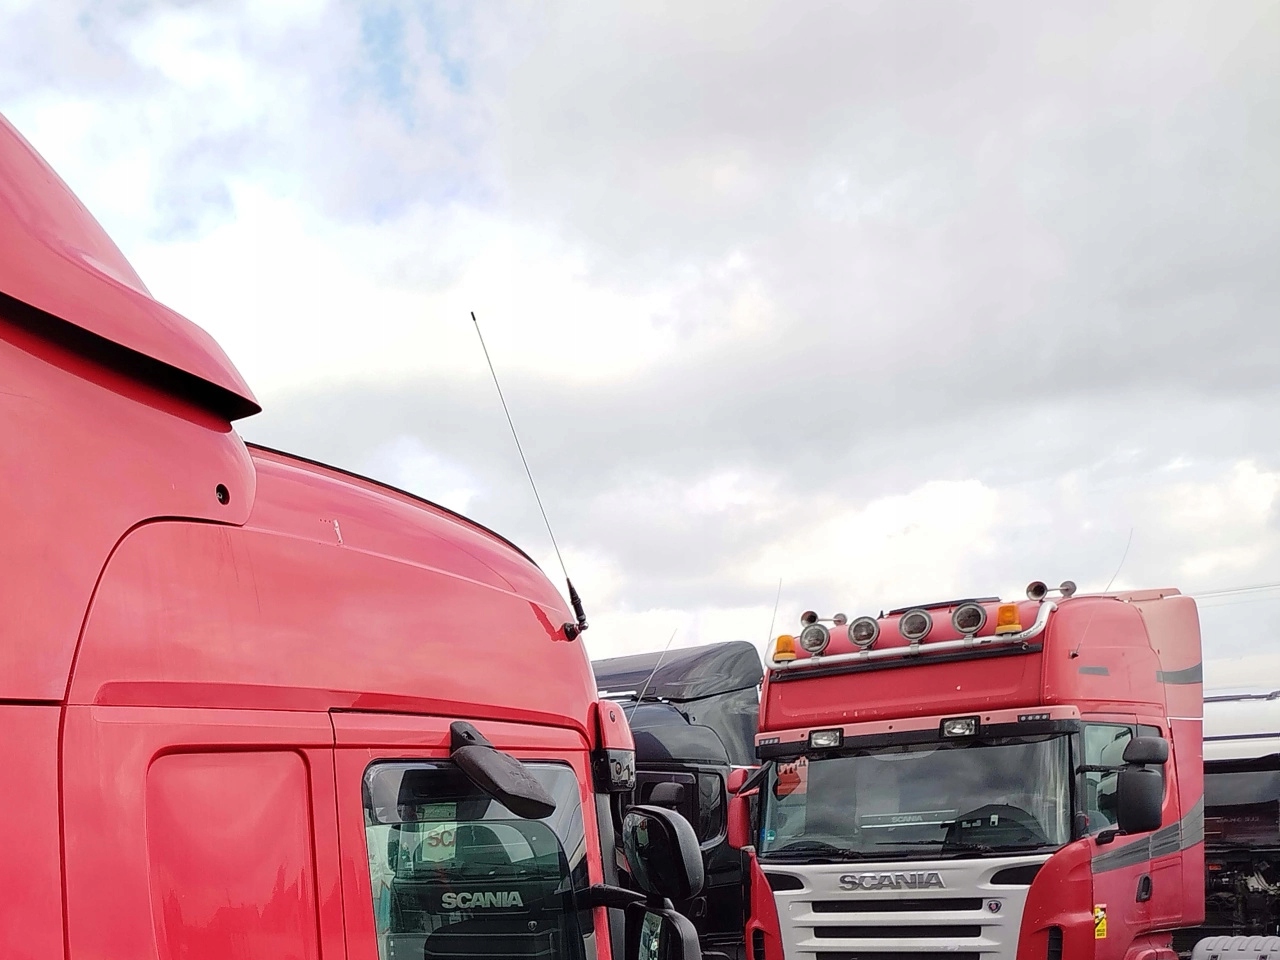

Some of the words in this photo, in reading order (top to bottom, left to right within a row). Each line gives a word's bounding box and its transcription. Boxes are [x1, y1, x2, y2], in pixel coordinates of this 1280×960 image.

[891, 815, 924, 823] SCANIA
[427, 829, 457, 847] SC
[839, 871, 947, 891] SCANIA
[441, 891, 524, 909] SCANIA
